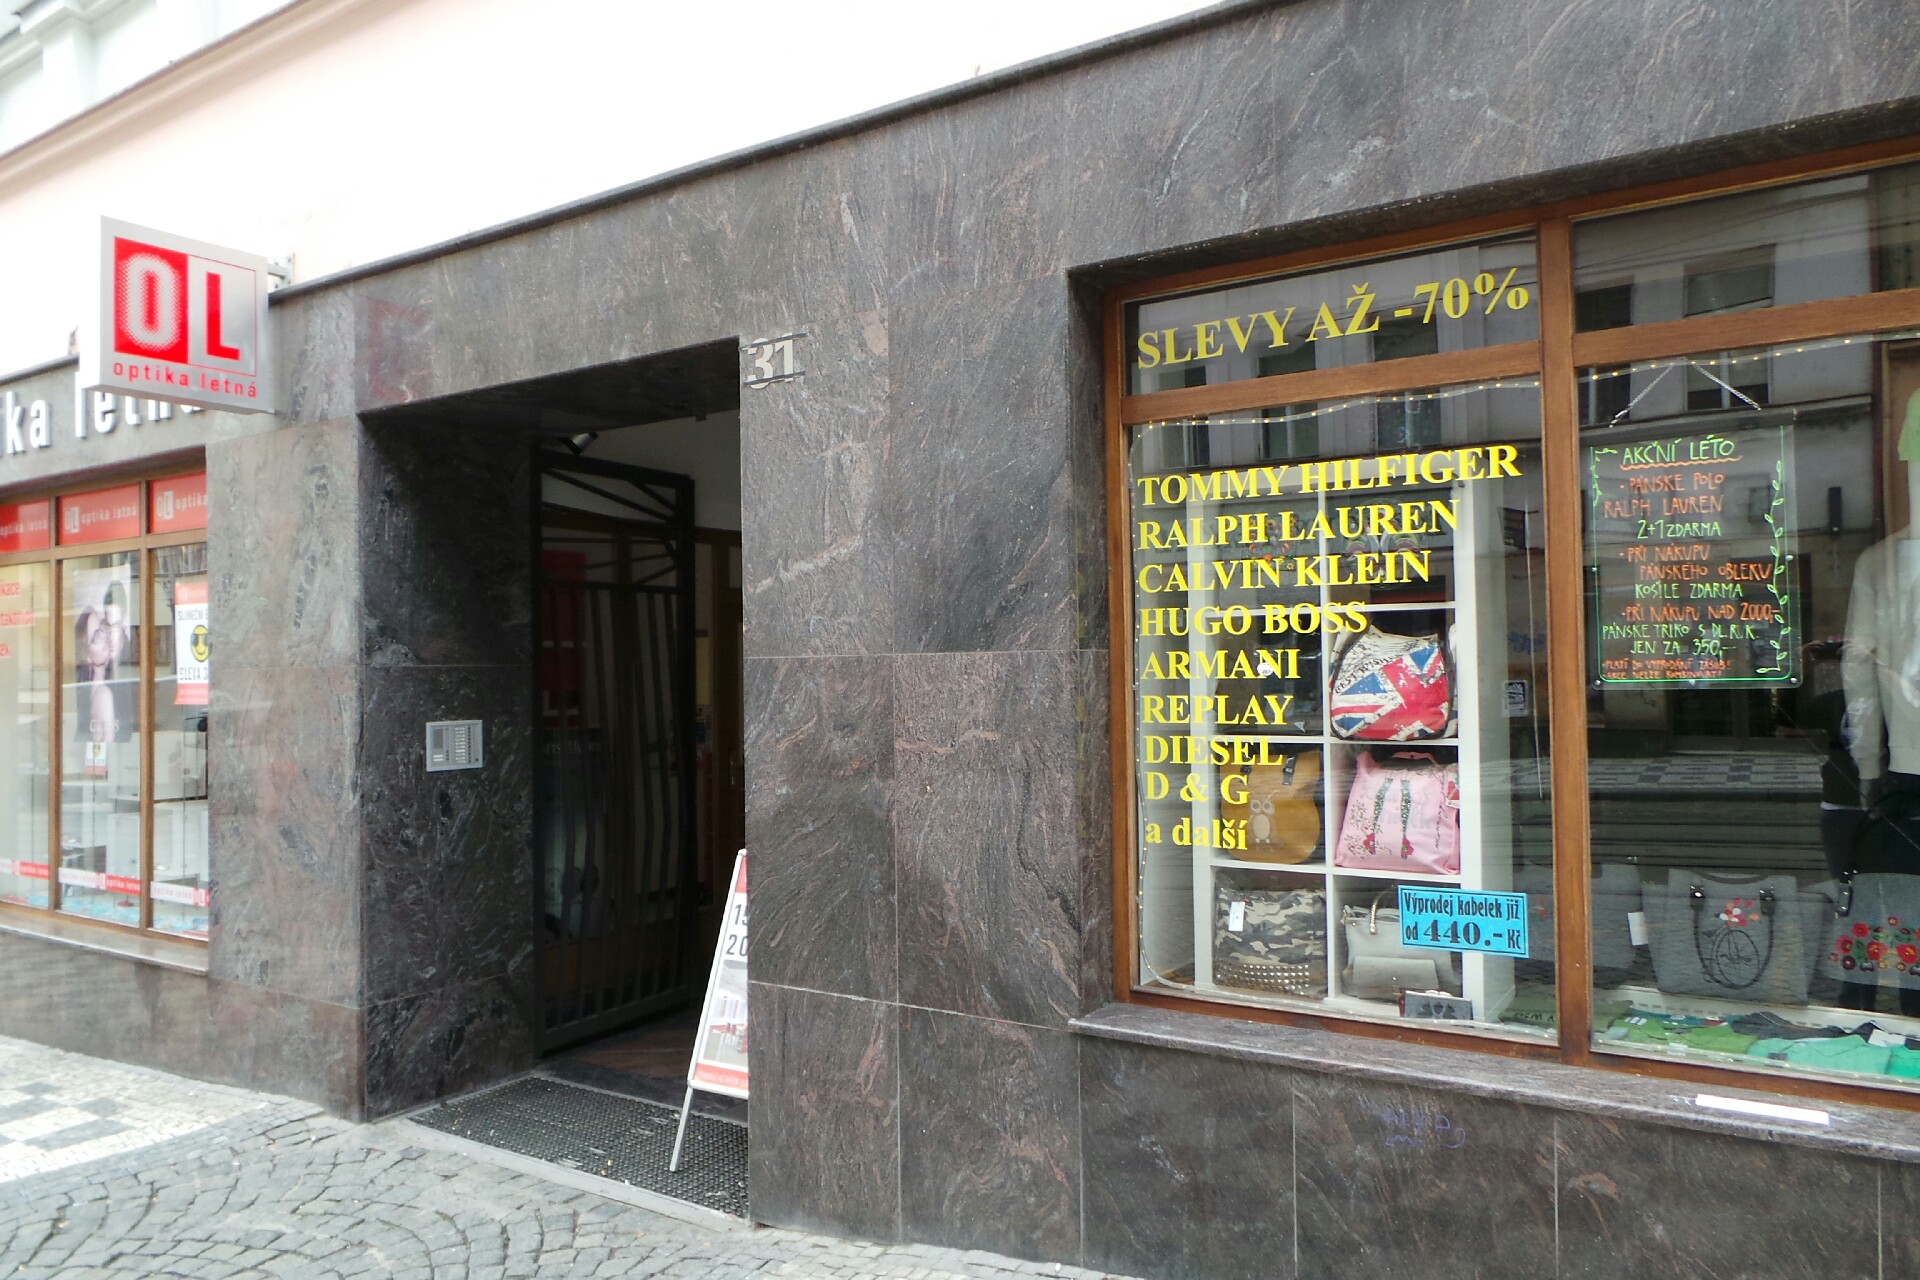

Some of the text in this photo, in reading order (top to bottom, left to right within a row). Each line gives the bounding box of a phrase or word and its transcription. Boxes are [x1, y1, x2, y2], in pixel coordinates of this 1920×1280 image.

[1136, 267, 1529, 370] SLEVY AŽ -70%
[747, 332, 794, 390] 31
[112, 361, 257, 398] optika letná
[1622, 435, 1736, 465] AKČNÍ LÉTO
[1137, 444, 1523, 507] TOMMY HILFIGER
[1603, 499, 1651, 518] RALPH
[1137, 499, 1460, 550] RALPH LAUREN
[1138, 549, 1432, 594] CALVIN KLEIN
[1689, 582, 1744, 598] ZDARMA
[1138, 600, 1369, 637] HUGO BOSS
[1707, 604, 1736, 620] NAD
[1653, 624, 1691, 639] TRIKO
[1630, 640, 1657, 655] JEN
[1662, 640, 1681, 656] ZA
[1140, 648, 1302, 680] ARMANI
[1142, 695, 1294, 726] REPLAY
[1143, 735, 1284, 766] DIESEL
[1145, 771, 1250, 805] D & G
[1145, 817, 1248, 850] a další
[1403, 892, 1521, 921] Výprodej kabelek již
[1405, 921, 1419, 941] od
[1507, 928, 1521, 950] Kč
